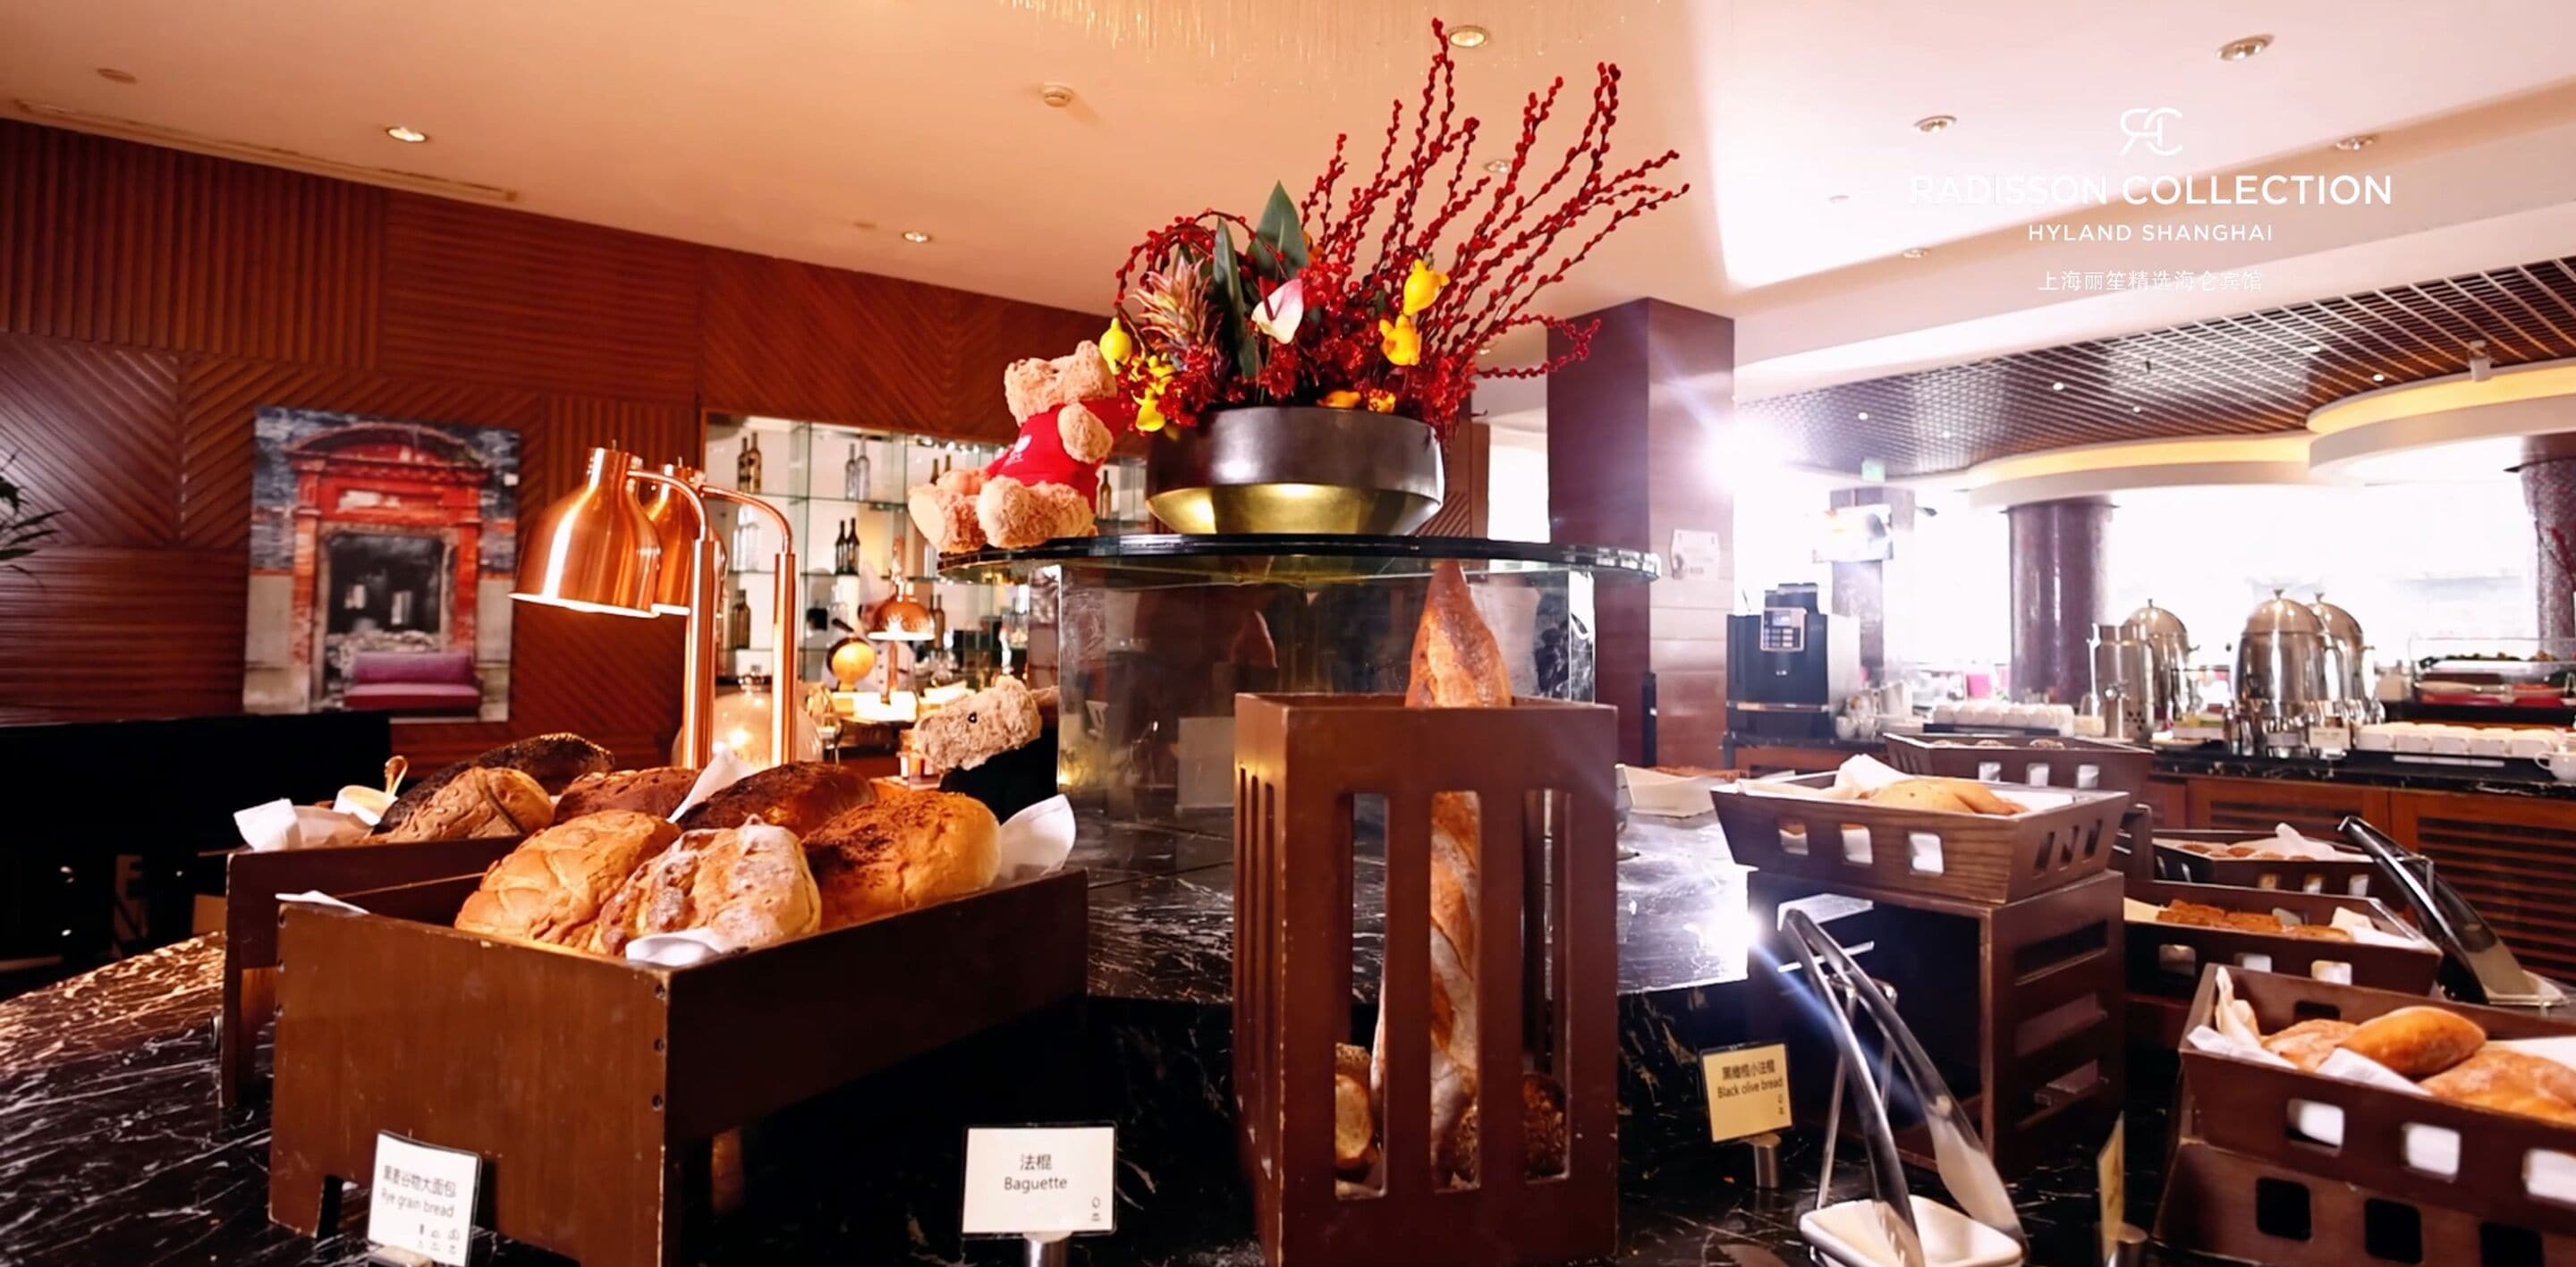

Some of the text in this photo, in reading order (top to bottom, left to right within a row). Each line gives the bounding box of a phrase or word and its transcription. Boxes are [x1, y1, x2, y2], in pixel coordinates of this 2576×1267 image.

[1717, 1077, 1783, 1099] Black olive bread
[1020, 1153, 1053, 1170] 法棍
[1004, 1176, 1068, 1194] Baguette
[397, 1195, 421, 1210] grain
[423, 1201, 454, 1218] bread
